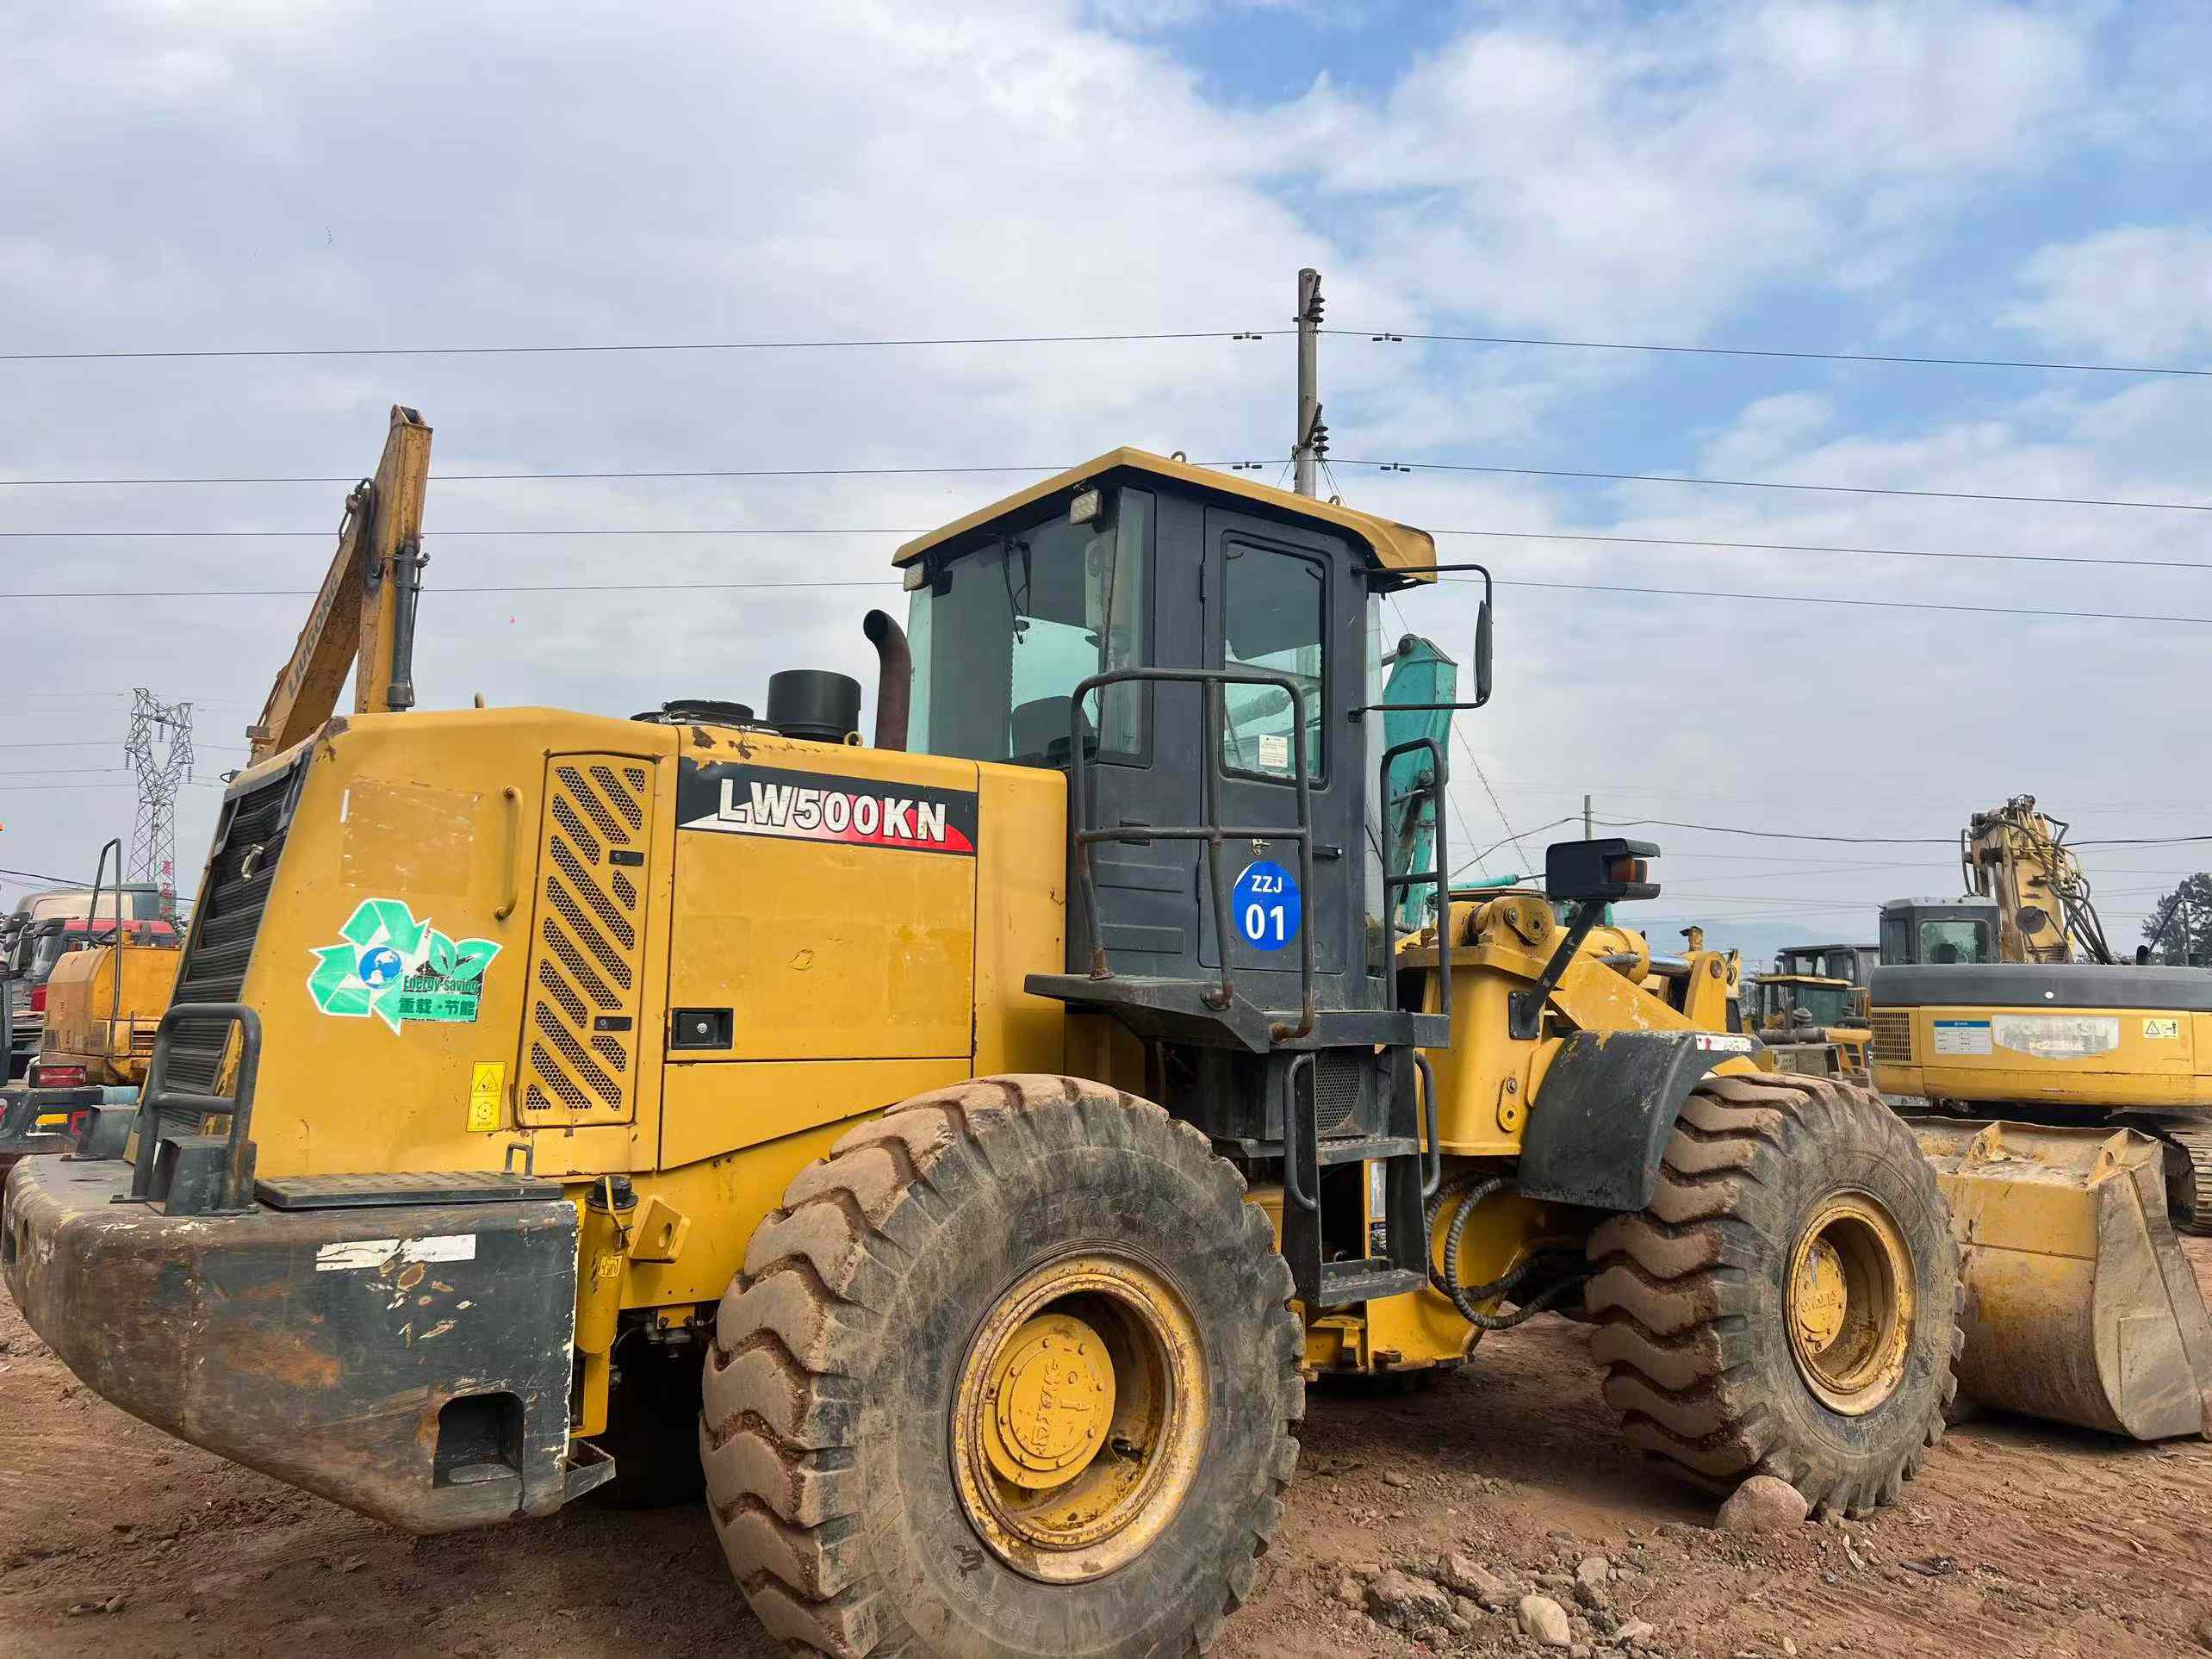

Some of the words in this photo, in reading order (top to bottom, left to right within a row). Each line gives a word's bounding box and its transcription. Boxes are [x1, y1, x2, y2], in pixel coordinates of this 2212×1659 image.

[718, 778, 947, 842] LW500KN
[1251, 874, 1283, 893] ZZJ
[1246, 904, 1284, 941] 01
